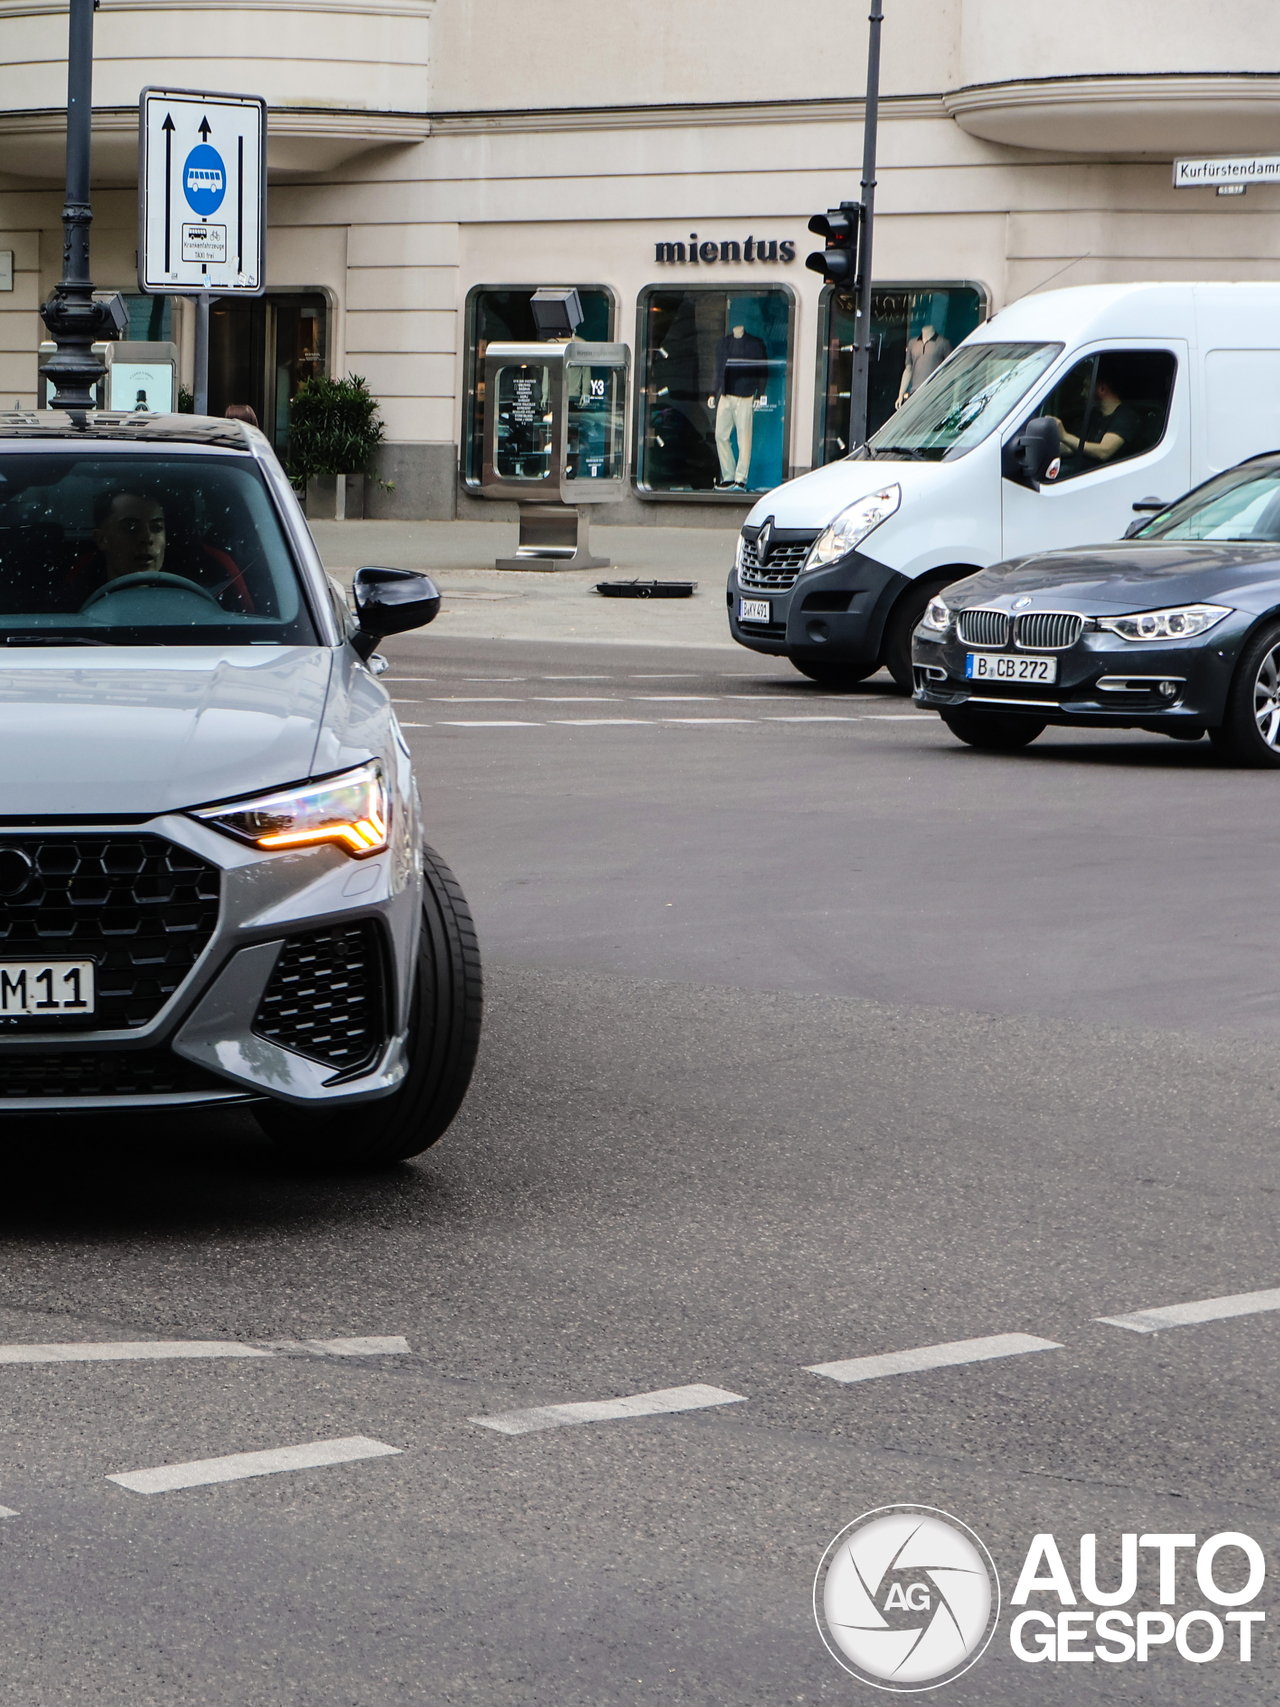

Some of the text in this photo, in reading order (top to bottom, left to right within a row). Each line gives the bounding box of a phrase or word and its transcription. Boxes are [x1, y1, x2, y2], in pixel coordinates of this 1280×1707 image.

[184, 241, 225, 251] Krankenfahrzeuge
[654, 233, 796, 263] mientus
[978, 658, 1049, 680] B CB 272
